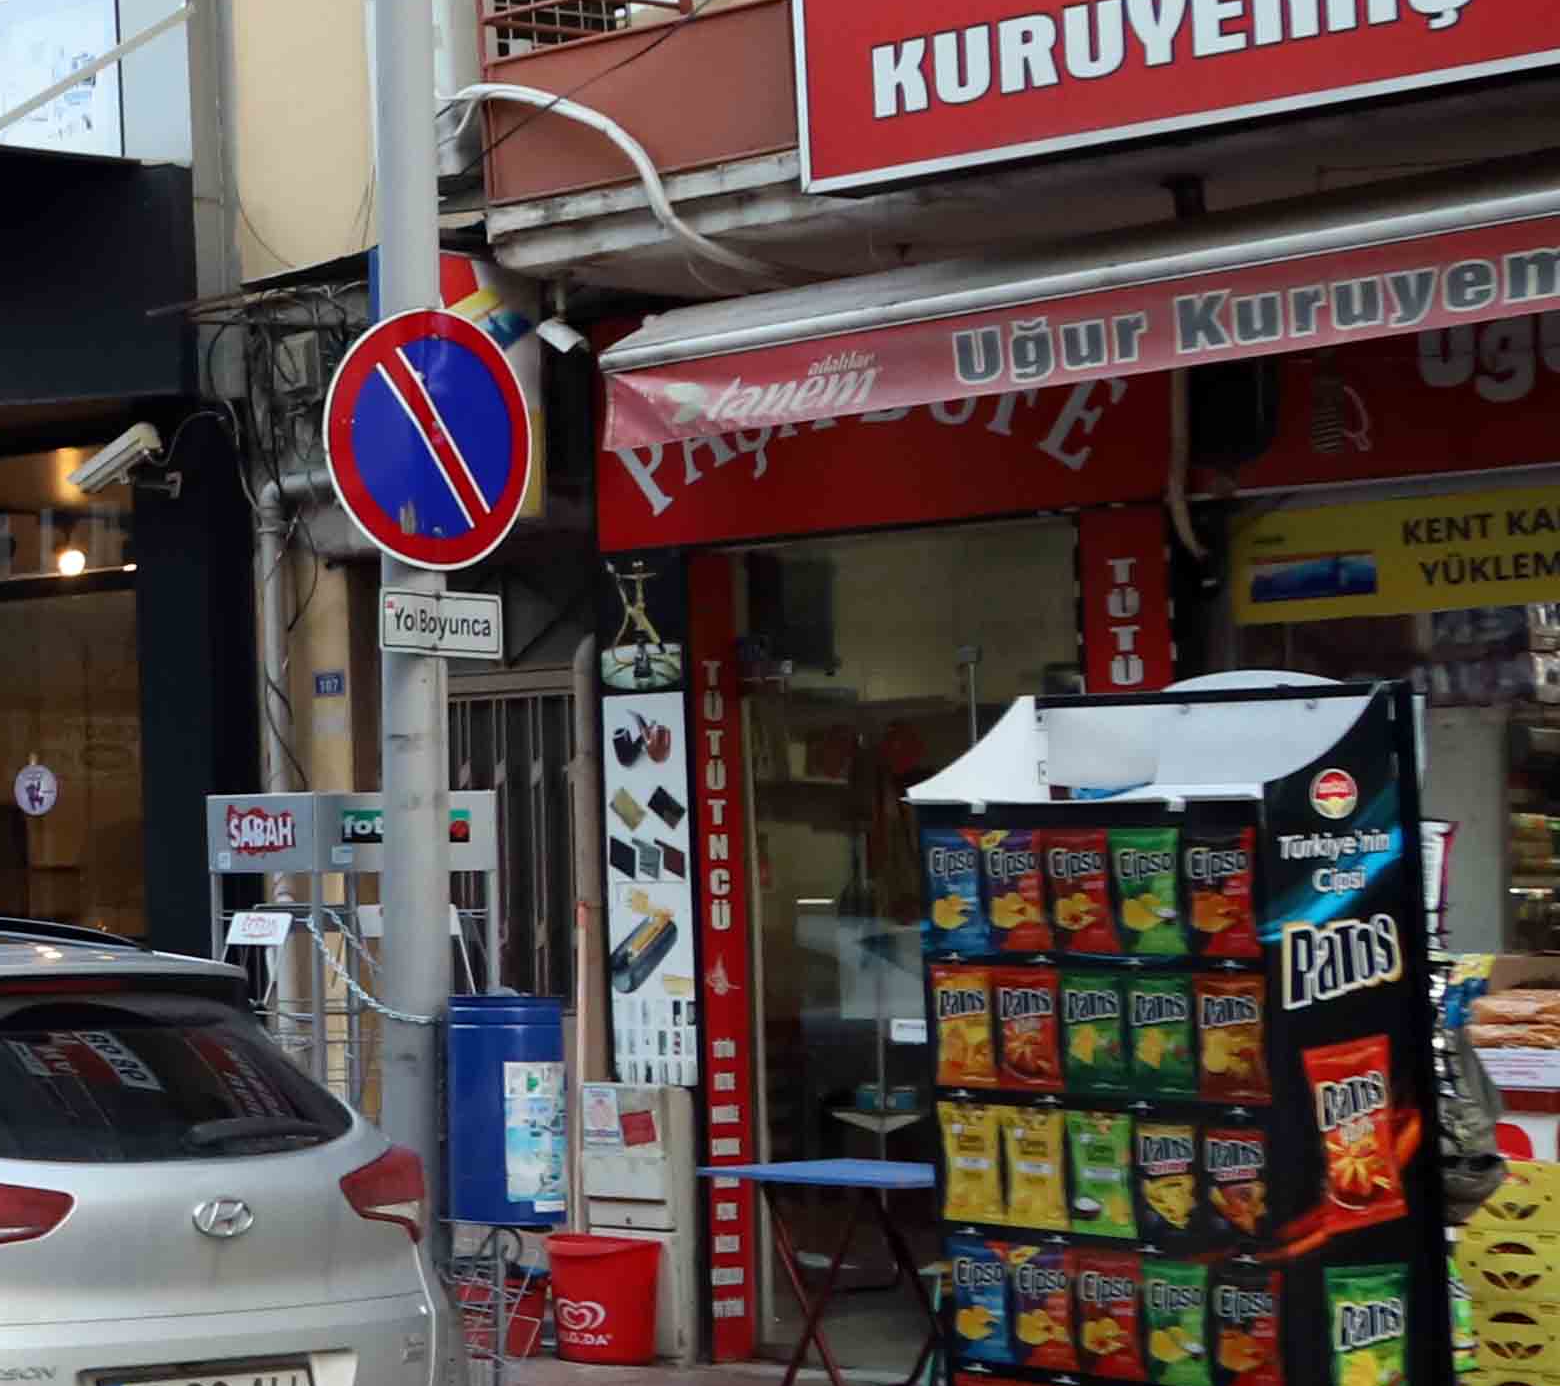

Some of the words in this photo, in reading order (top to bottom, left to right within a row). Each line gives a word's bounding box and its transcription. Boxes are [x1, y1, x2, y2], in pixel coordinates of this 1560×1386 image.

[952, 313, 1146, 387] Uğur
[706, 366, 876, 421] tanem
[1402, 512, 1493, 546] KENT
[1507, 503, 1560, 537] KA
[420, 607, 491, 642] Boyunca
[229, 813, 296, 849] SABAH
